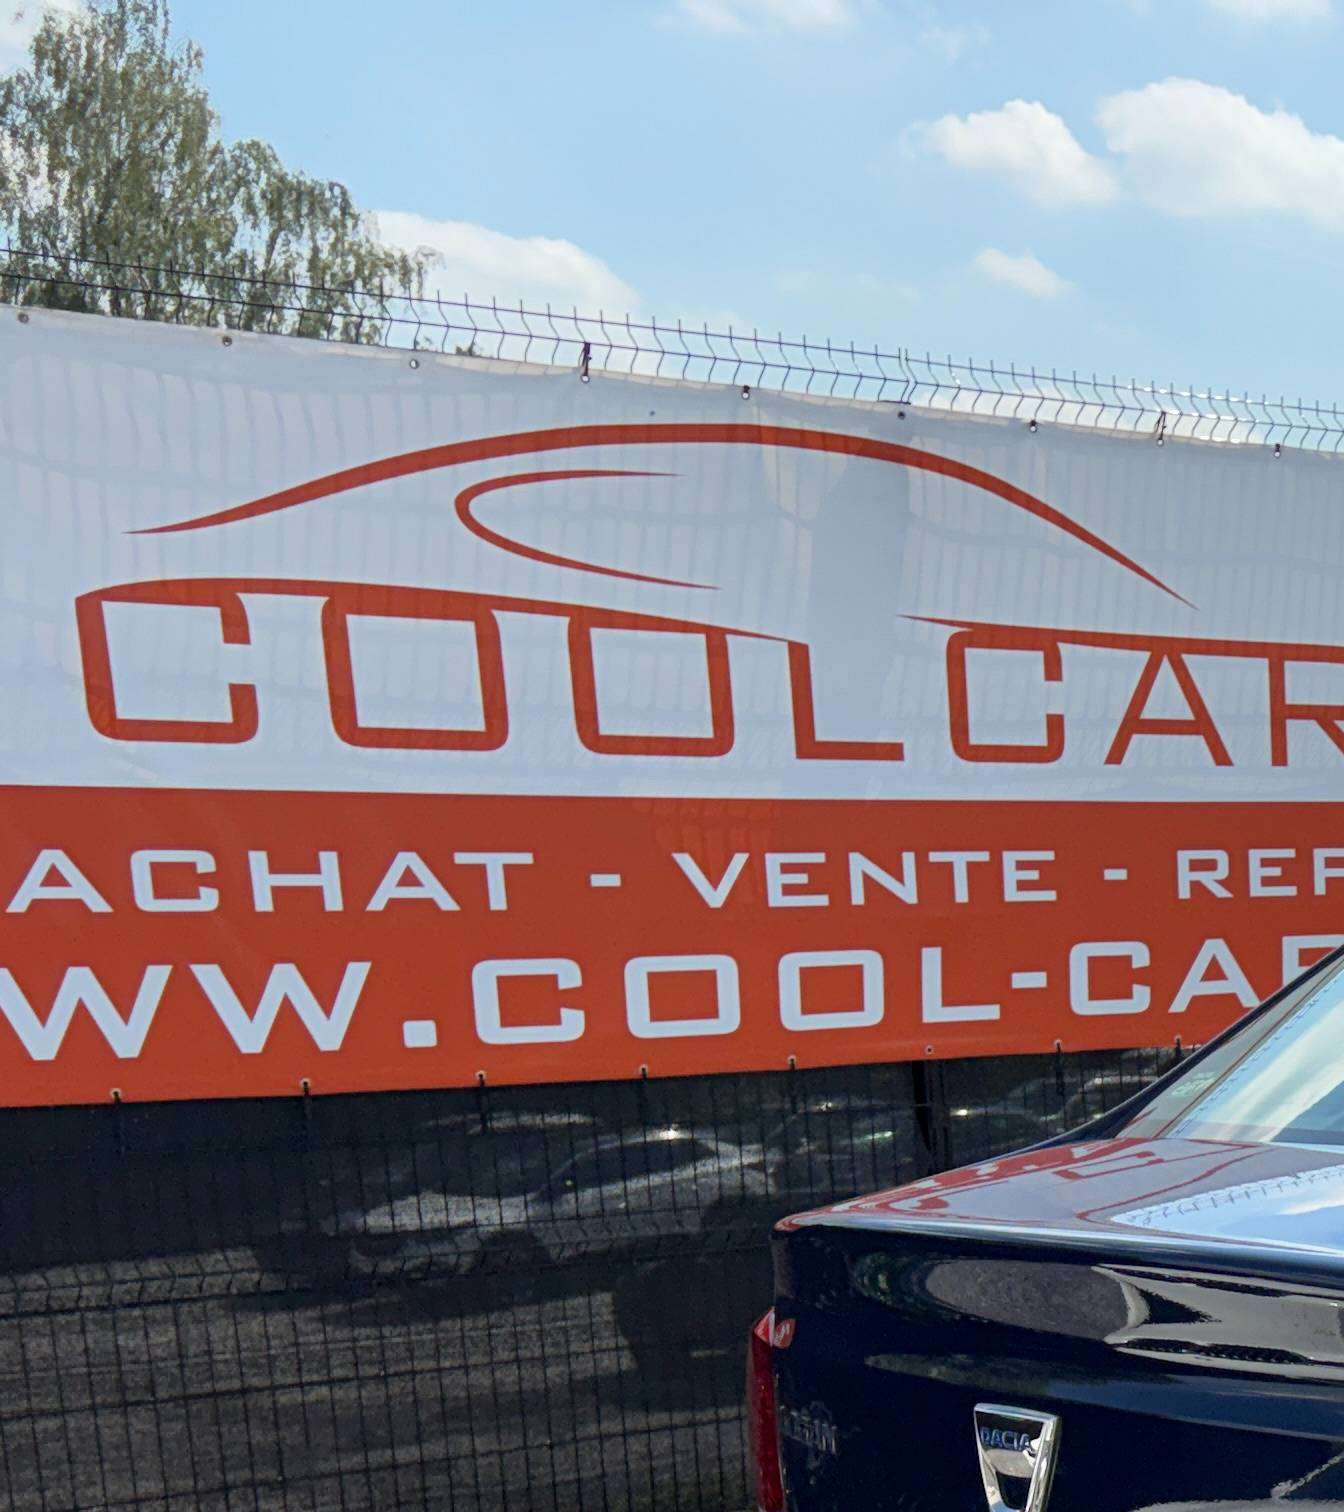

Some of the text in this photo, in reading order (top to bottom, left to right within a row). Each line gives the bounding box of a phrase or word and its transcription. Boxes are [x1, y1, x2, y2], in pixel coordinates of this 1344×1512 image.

[75, 577, 907, 761] COOL
[6, 849, 534, 912] ACHAT
[672, 850, 1057, 908] VENTE
[980, 1427, 1030, 1450] DACIA
